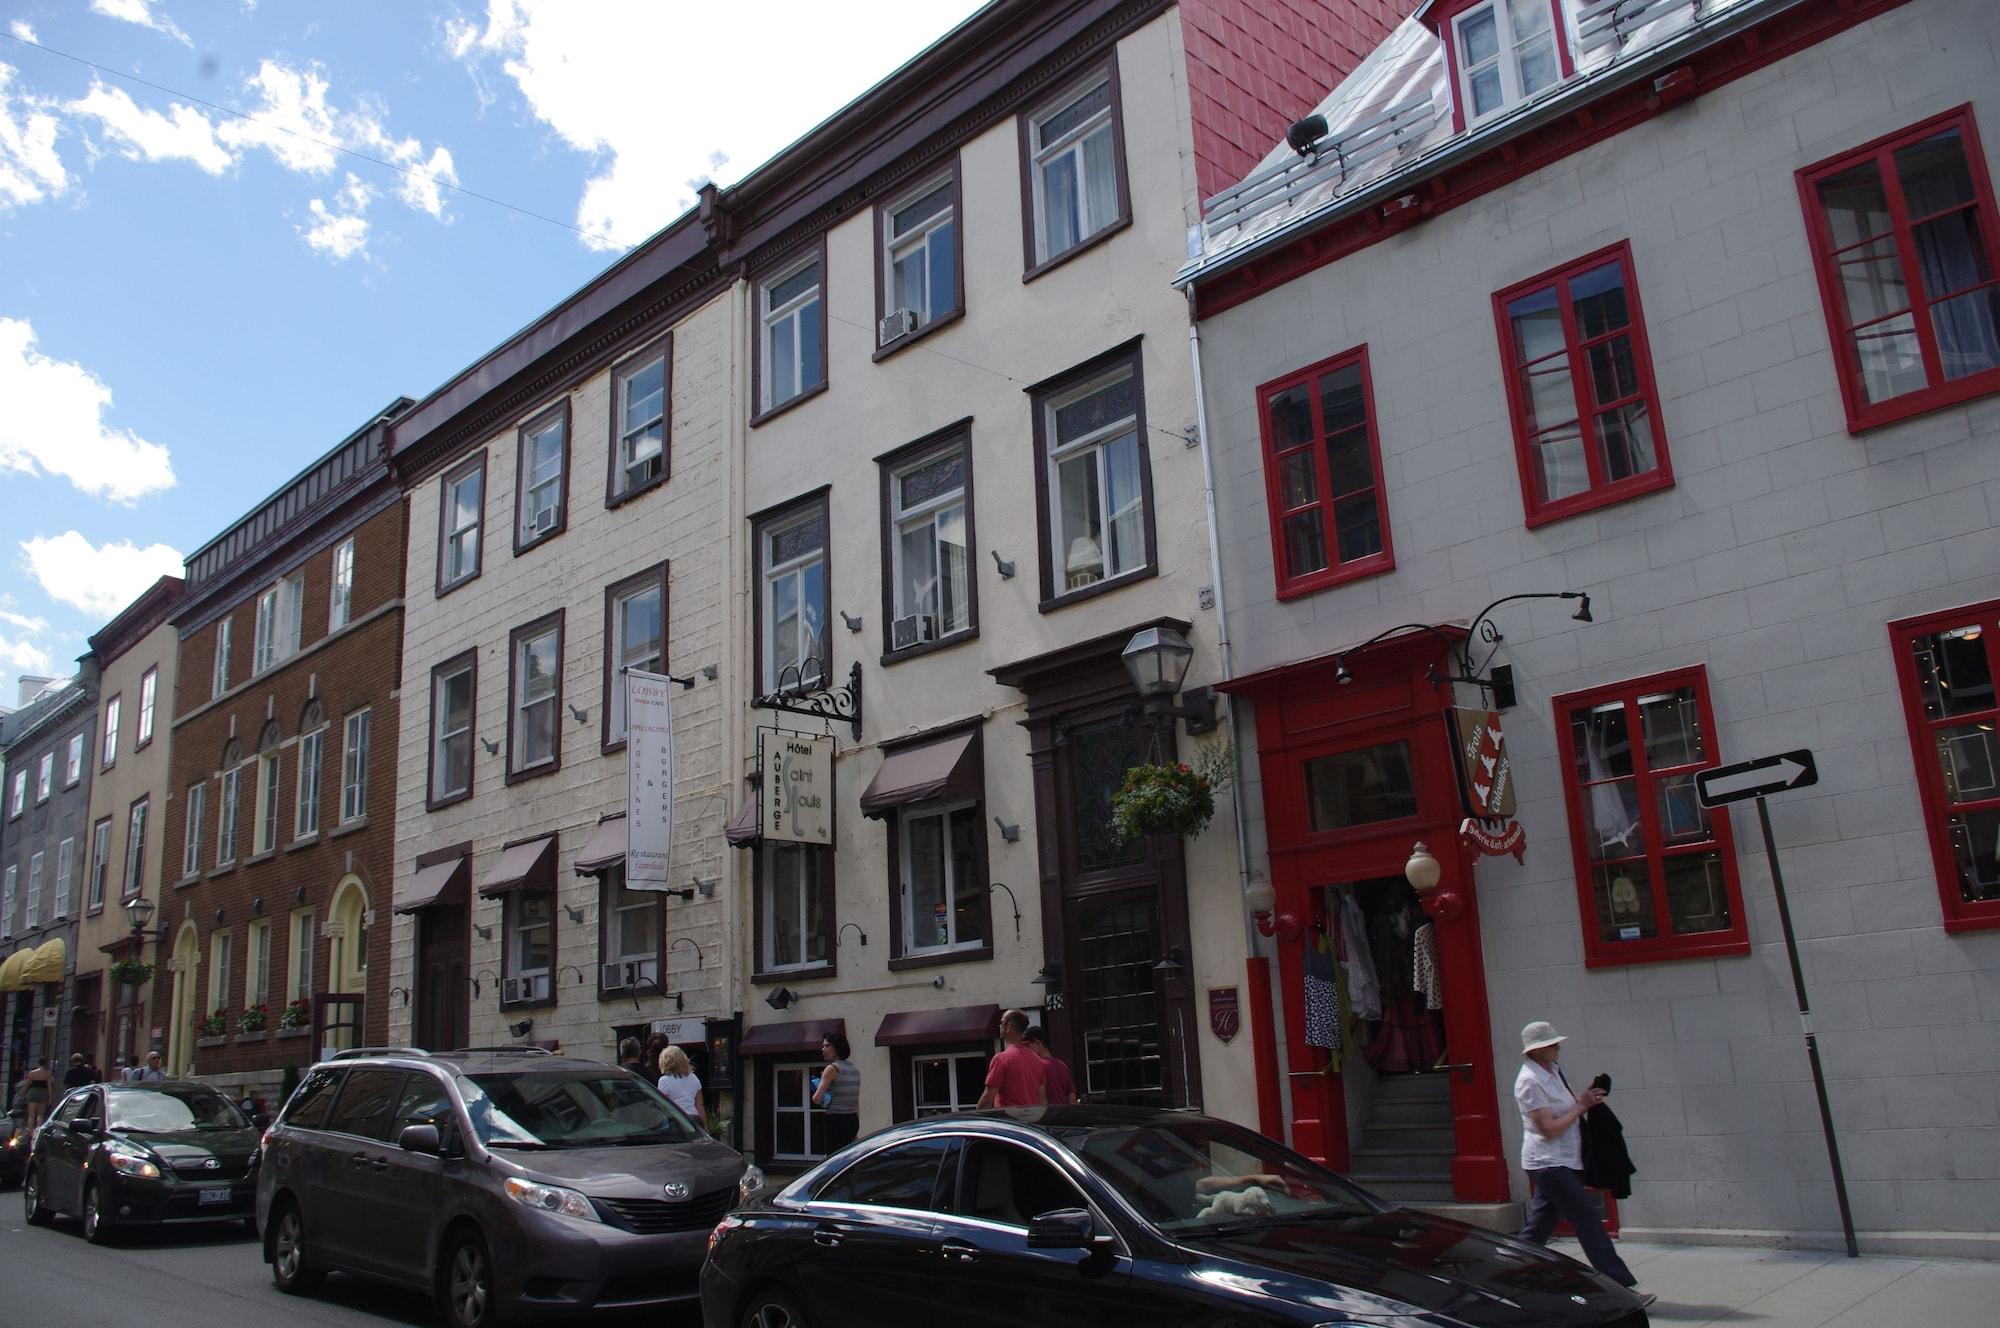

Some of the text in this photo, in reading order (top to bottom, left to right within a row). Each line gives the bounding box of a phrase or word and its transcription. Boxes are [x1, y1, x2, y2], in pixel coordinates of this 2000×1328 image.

[631, 685, 667, 697] LOBBY
[787, 742, 812, 755] Hôtel
[1467, 725, 1483, 759] Trois
[647, 779, 653, 787] &
[1492, 758, 1509, 813] Colombes
[1046, 993, 1064, 1010] 48
